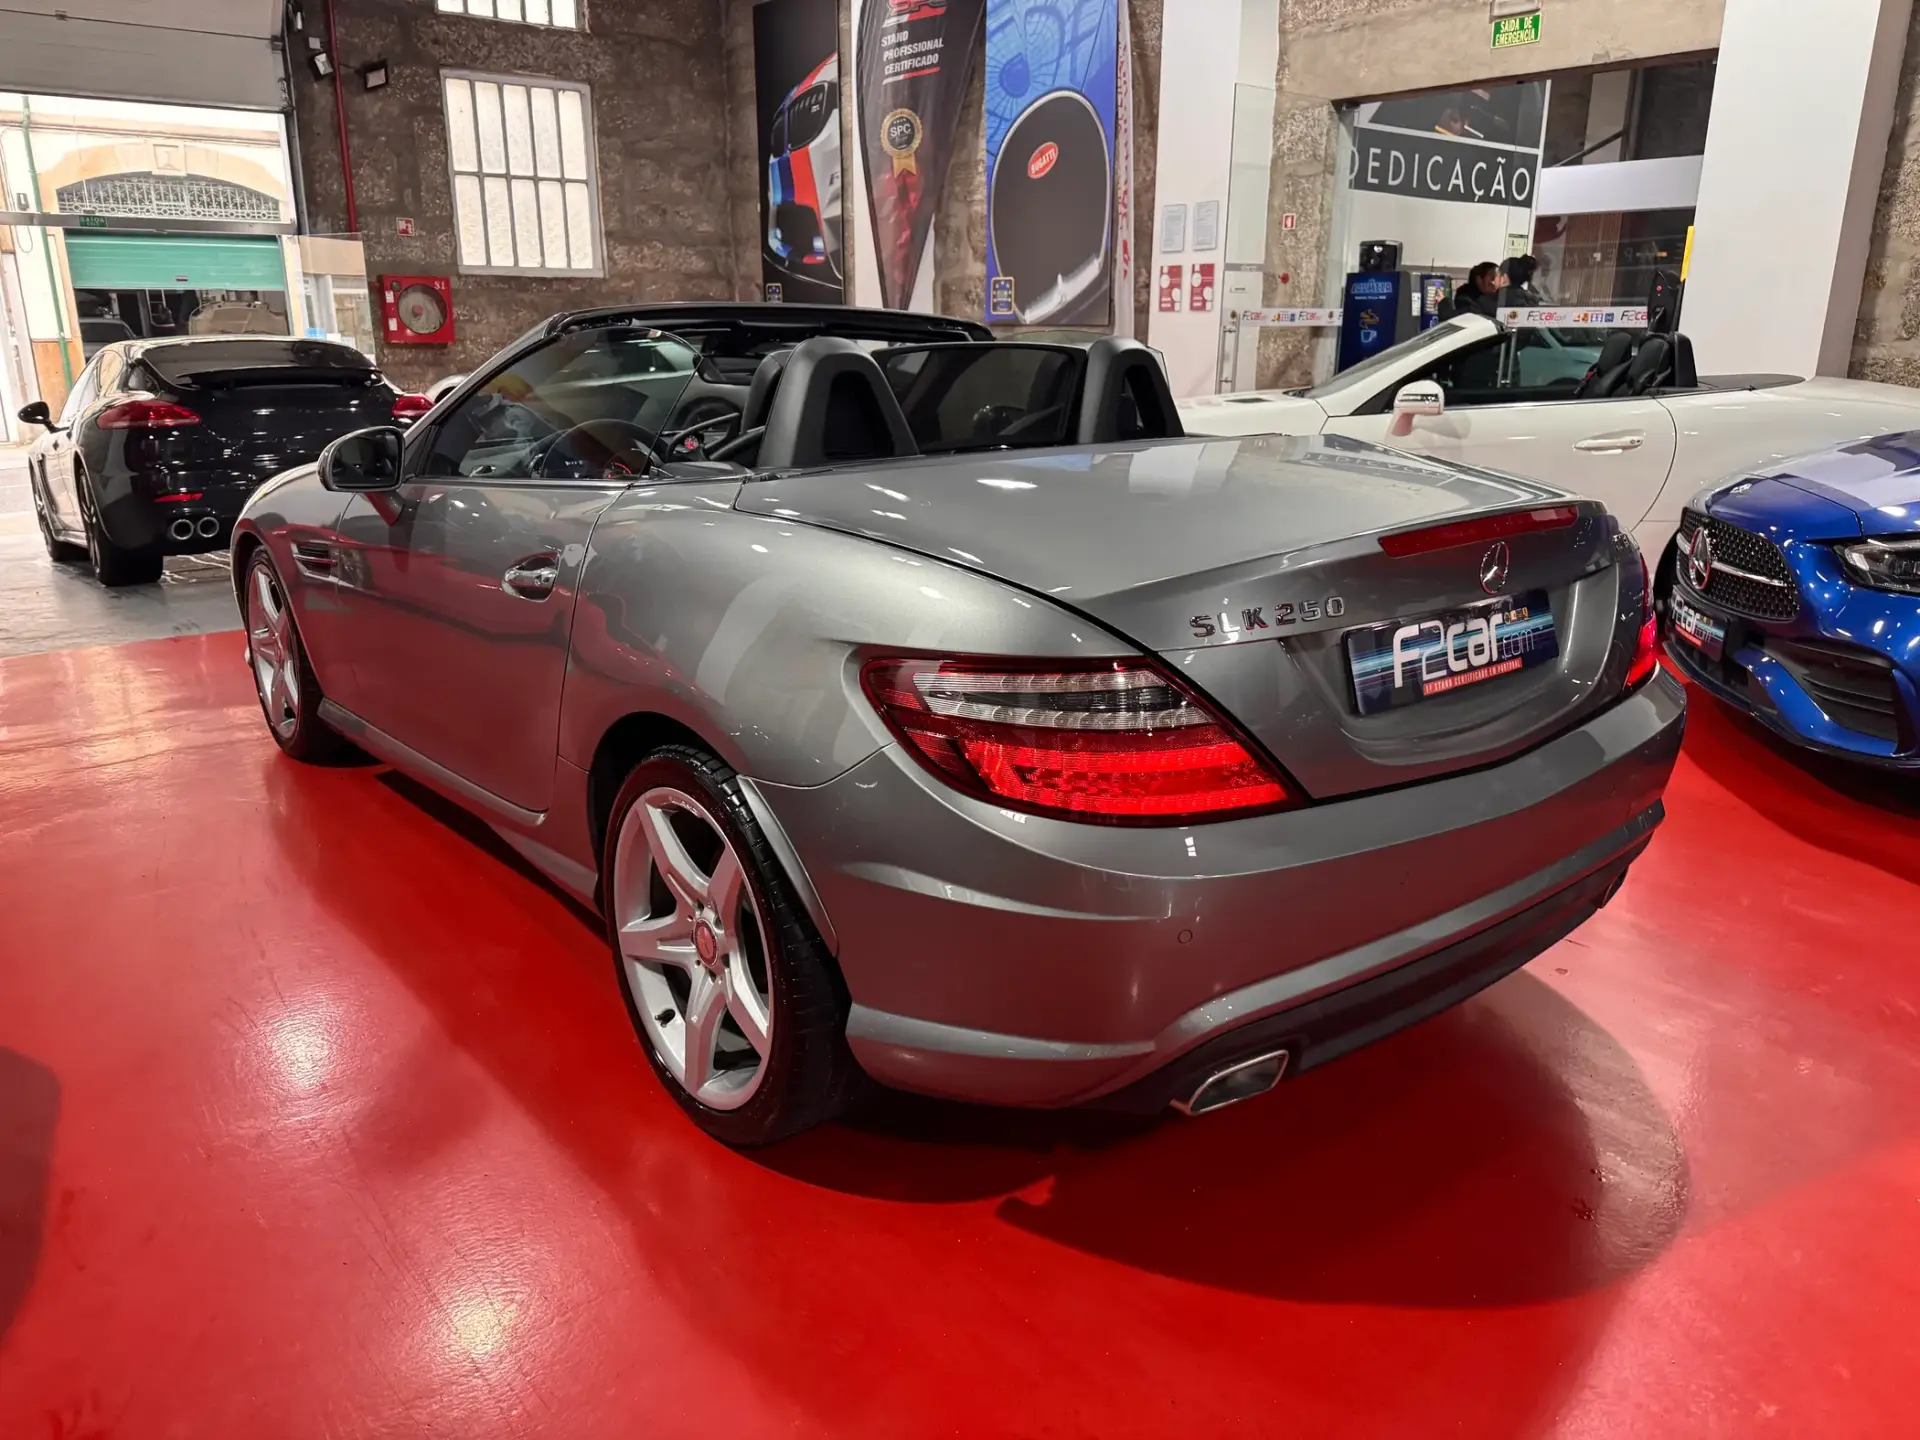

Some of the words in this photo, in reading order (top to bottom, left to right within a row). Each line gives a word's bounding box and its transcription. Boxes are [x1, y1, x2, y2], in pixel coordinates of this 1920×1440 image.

[1524, 17, 1533, 30] DE
[881, 30, 909, 47] STAND
[883, 37, 944, 62] PROFISSIONAL
[884, 53, 939, 75] CERTIFICADO
[890, 123, 911, 137] SPC
[1031, 147, 1056, 175] BUGATTI
[1189, 606, 1269, 638] SLK
[1274, 596, 1345, 627] 250
[1435, 679, 1452, 691] STAND
[1454, 670, 1488, 686] CERTIFICADO
